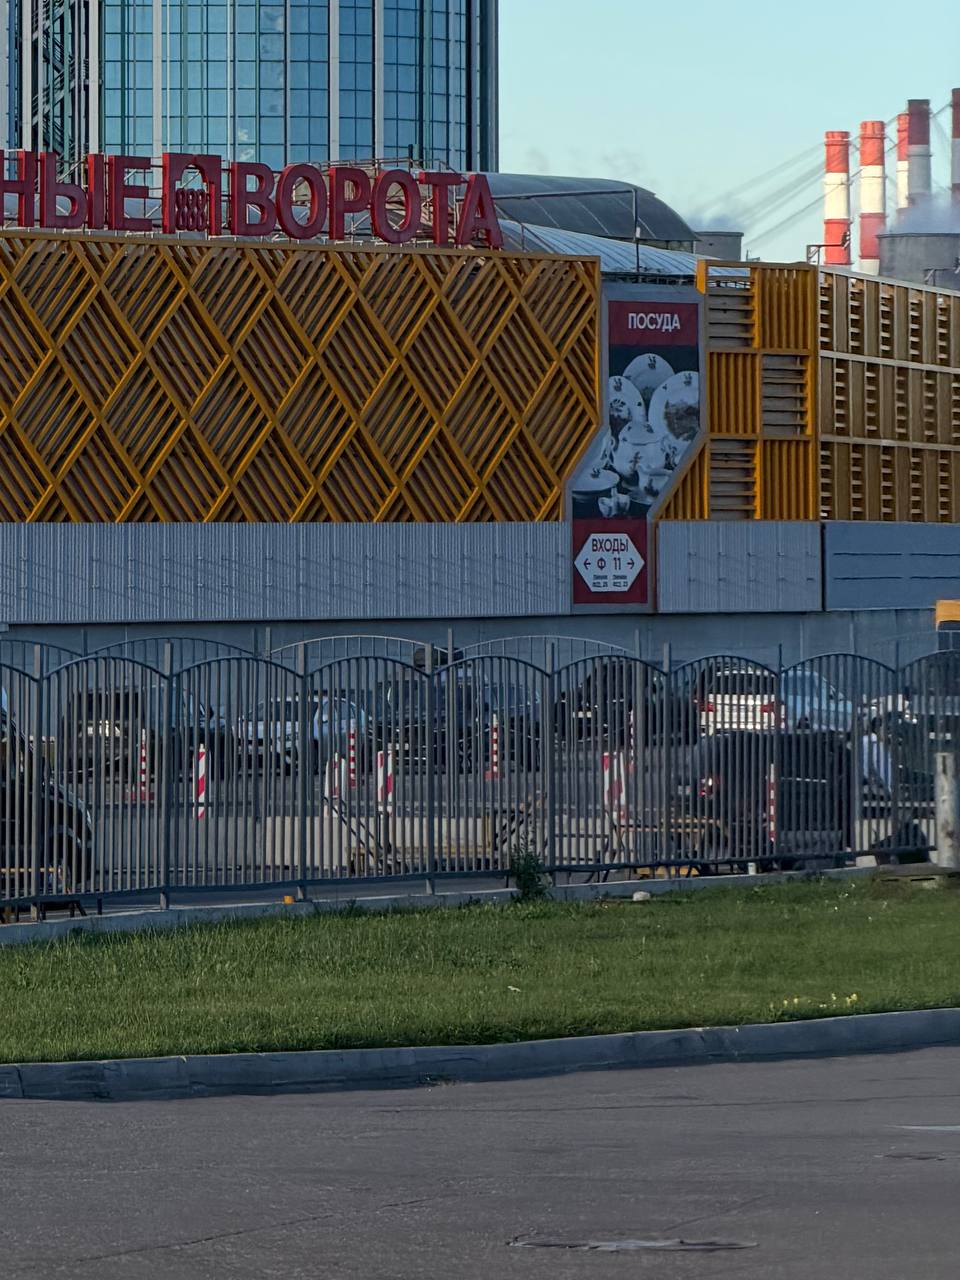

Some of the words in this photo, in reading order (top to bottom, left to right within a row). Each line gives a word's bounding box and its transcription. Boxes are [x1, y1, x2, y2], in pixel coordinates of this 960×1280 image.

[230, 161, 503, 249] ВОРОТА
[628, 313, 681, 332] ПОСУДА
[592, 538, 629, 554] ВХОДЫ
[597, 557, 607, 570] Ф
[613, 557, 622, 570] 11
